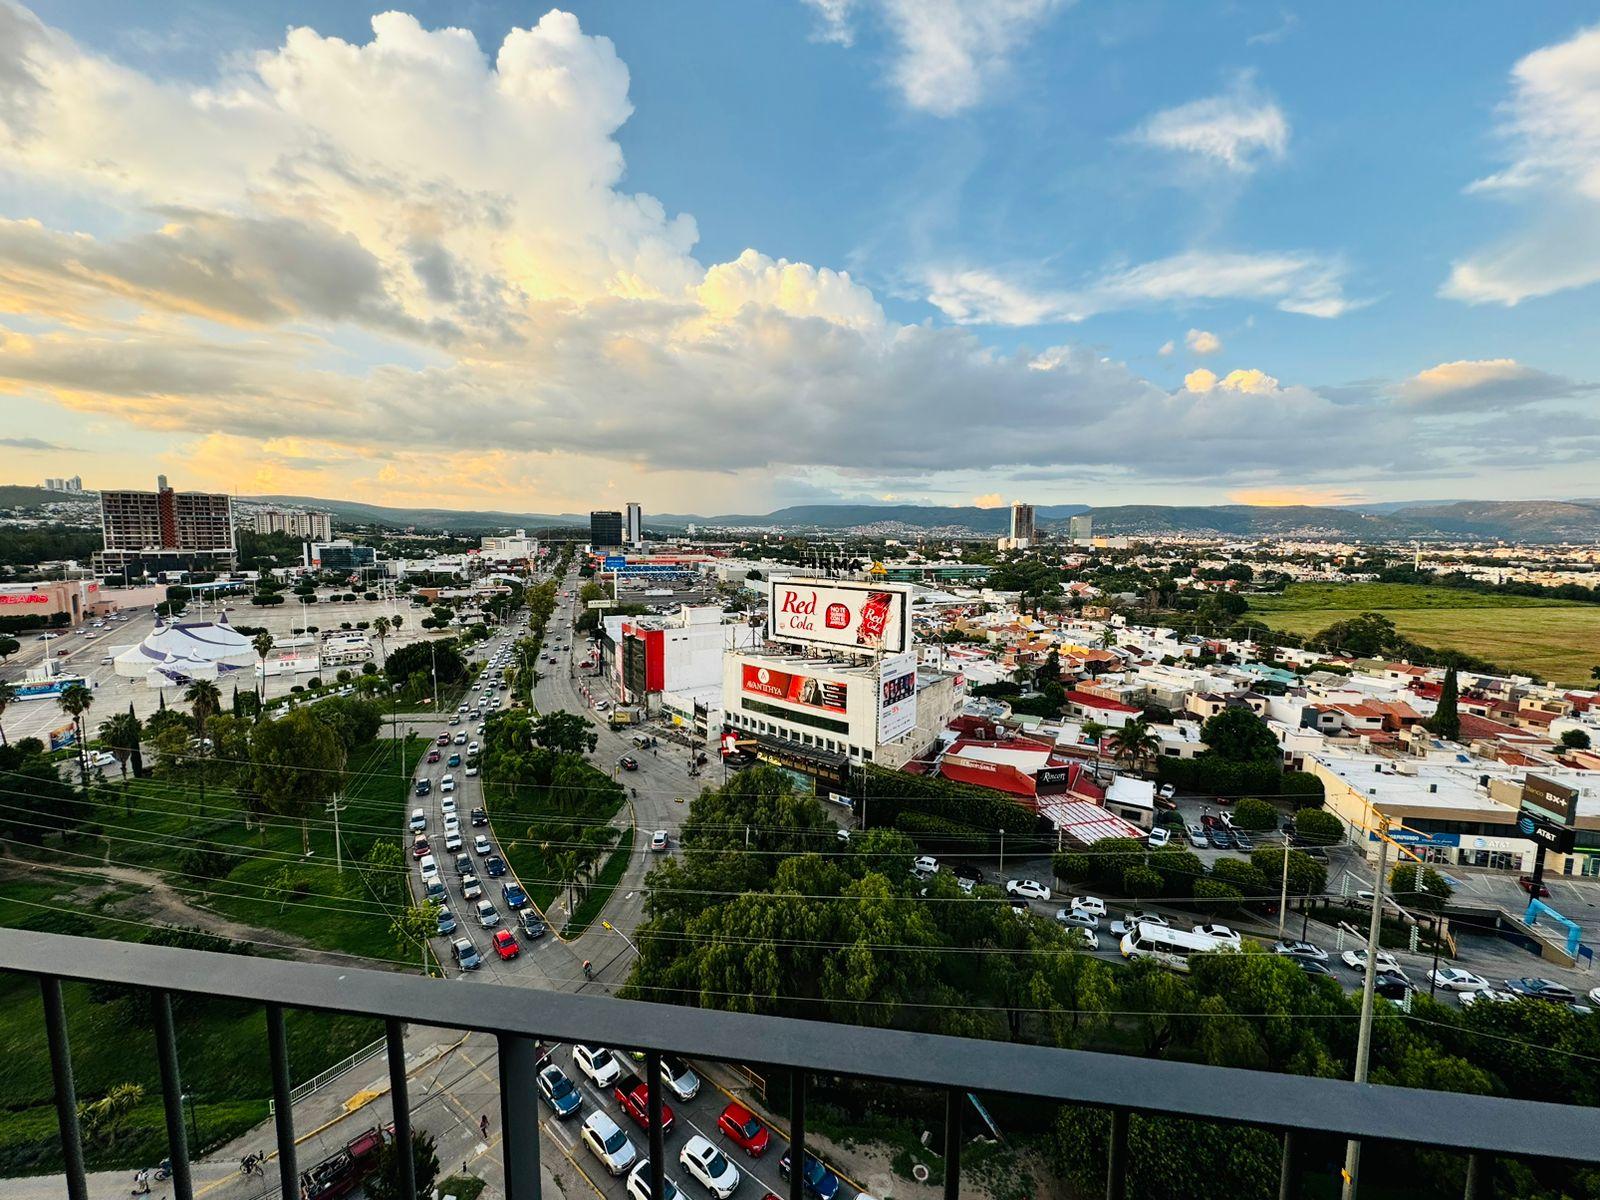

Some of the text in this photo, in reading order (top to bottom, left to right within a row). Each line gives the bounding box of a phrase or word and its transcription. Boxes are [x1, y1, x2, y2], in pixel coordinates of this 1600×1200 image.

[781, 591, 817, 615] Red
[790, 615, 813, 631] Cola
[865, 608, 885, 624] Red
[1525, 785, 1567, 807] Banco BX+
[1536, 828, 1557, 842] AT&T
[1488, 840, 1511, 848] AT&T
